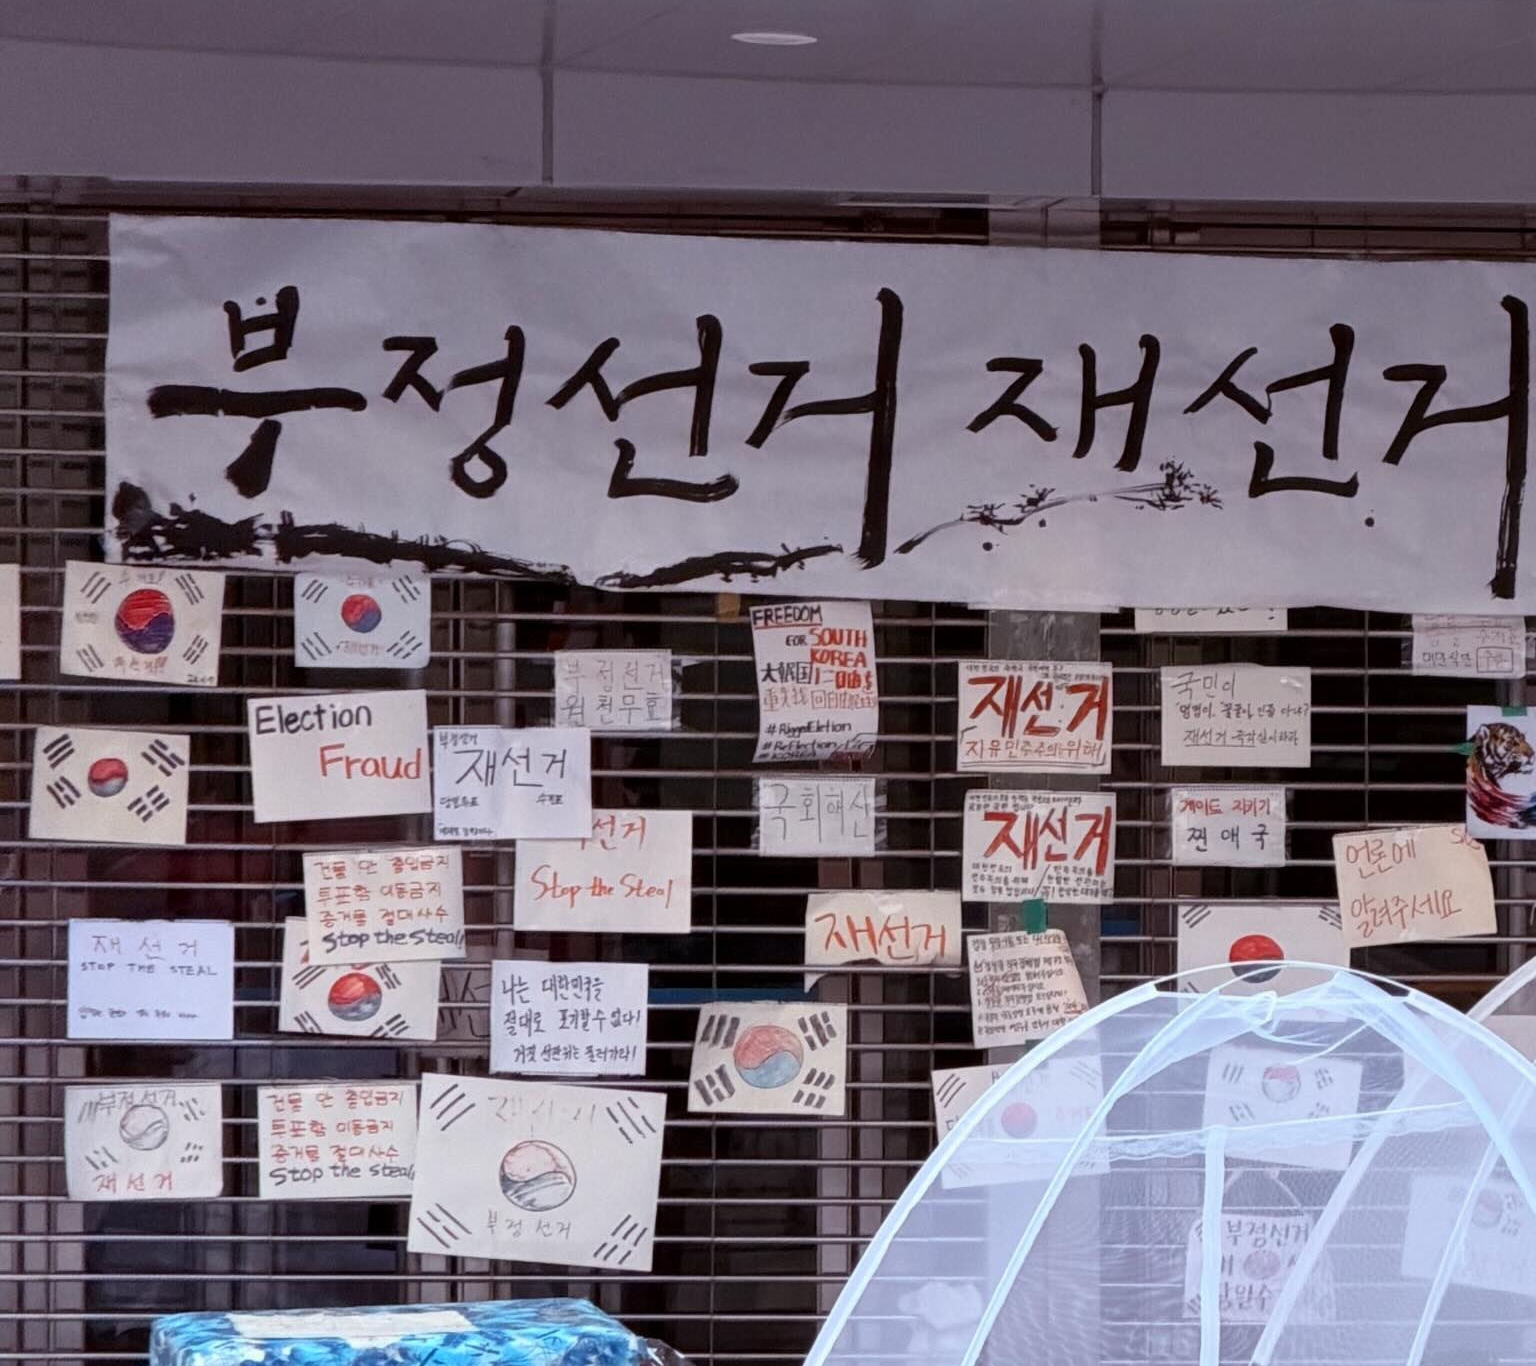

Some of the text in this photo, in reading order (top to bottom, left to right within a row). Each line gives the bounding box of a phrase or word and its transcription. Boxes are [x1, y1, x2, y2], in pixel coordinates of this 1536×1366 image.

[148, 286, 903, 569] 부정선거
[753, 605, 823, 626] FREEDOM
[810, 628, 868, 648] SOUTH
[810, 649, 867, 667] KOREA
[1171, 671, 1236, 701] 국민이
[255, 704, 372, 734] Election
[968, 675, 1109, 741] 재선거
[319, 743, 422, 779] Fraud
[453, 747, 567, 787] 재선거
[581, 814, 646, 851] 선거
[984, 806, 1112, 876] 재선거
[1346, 838, 1416, 879] 언론에
[531, 864, 673, 909] Stop the Steal
[1351, 889, 1462, 938] 알려주세요
[92, 935, 197, 961] 재선거
[815, 913, 947, 960] 재선거
[502, 973, 530, 1005] 나는
[541, 973, 604, 1002] 대한민국을
